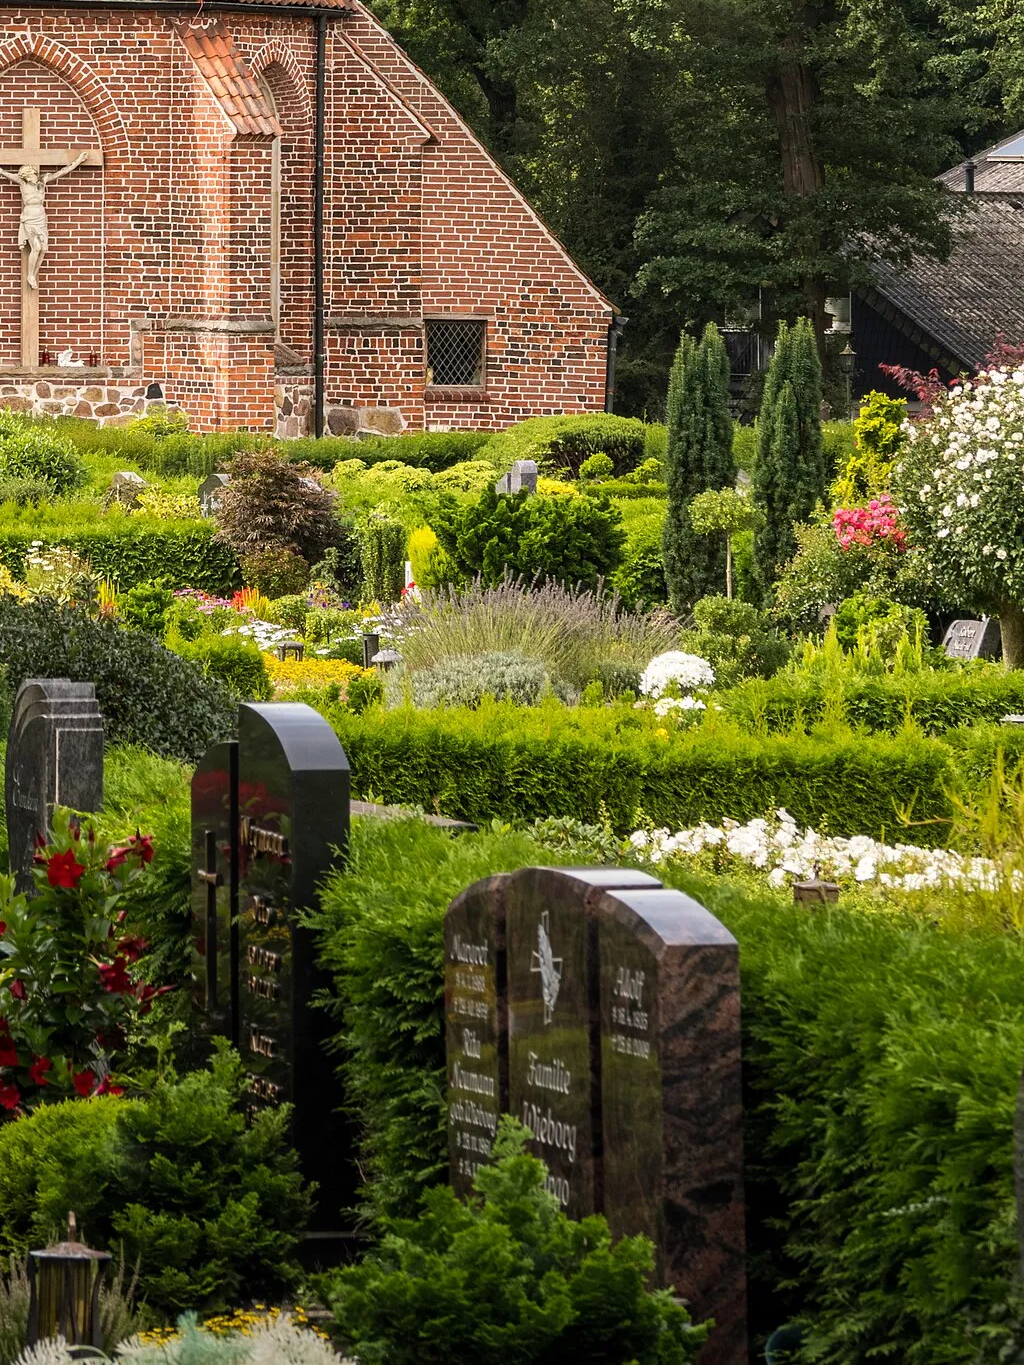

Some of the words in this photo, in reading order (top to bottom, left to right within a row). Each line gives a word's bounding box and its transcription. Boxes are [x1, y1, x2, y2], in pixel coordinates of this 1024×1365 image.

[462, 1027, 481, 1059] Rita
[450, 1060, 495, 1098] Neumann
[526, 1050, 572, 1095] Familie
[522, 1100, 578, 1163] Wieborg
